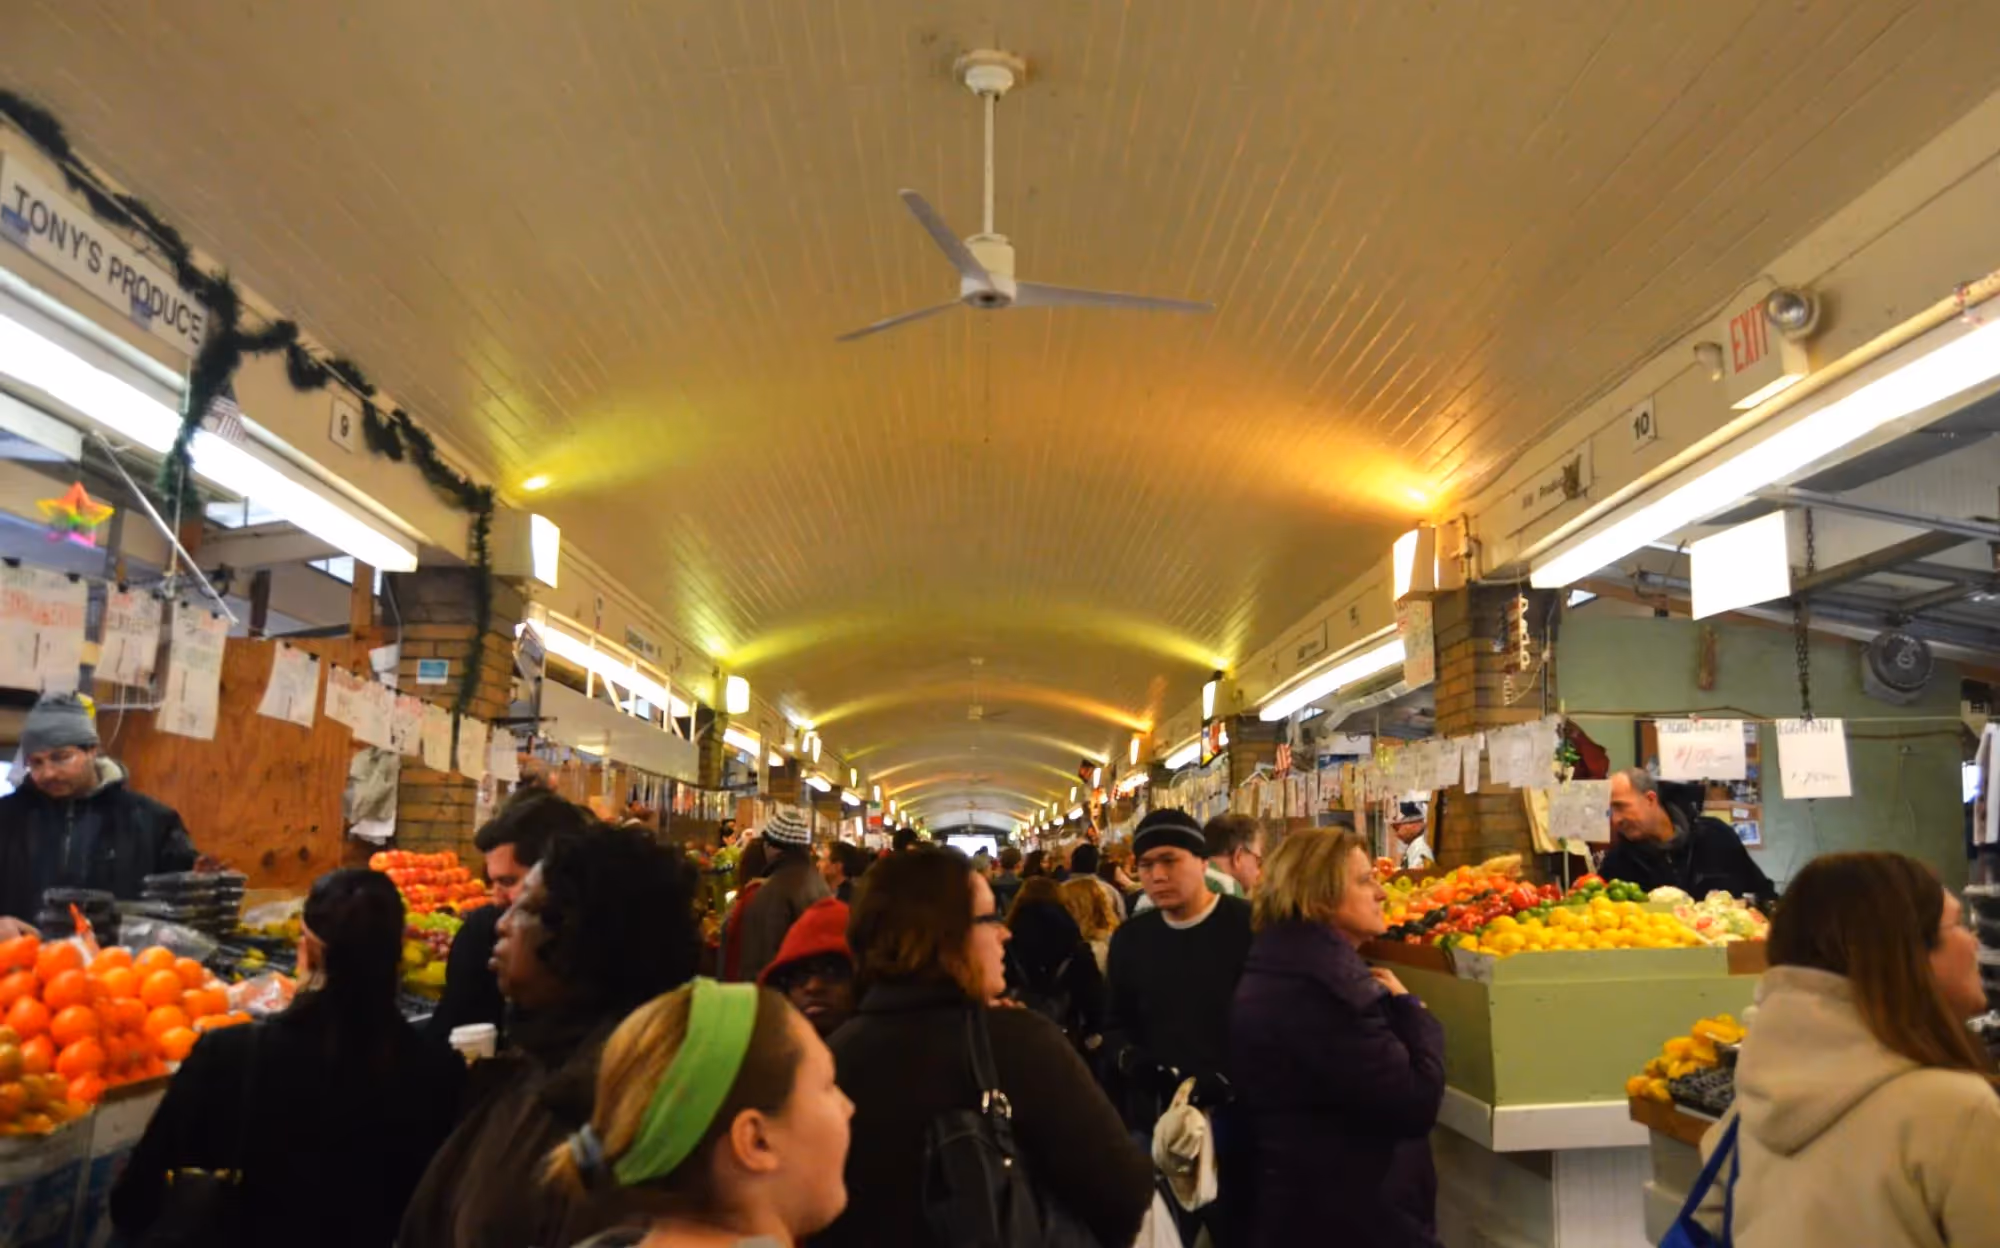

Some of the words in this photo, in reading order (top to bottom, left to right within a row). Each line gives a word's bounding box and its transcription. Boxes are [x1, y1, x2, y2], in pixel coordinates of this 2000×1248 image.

[14, 184, 102, 274] TONY'S
[108, 255, 203, 344] PRODUCE
[1729, 300, 1769, 374] EXIT
[341, 413, 349, 437] 9
[1633, 411, 1649, 440] 10
